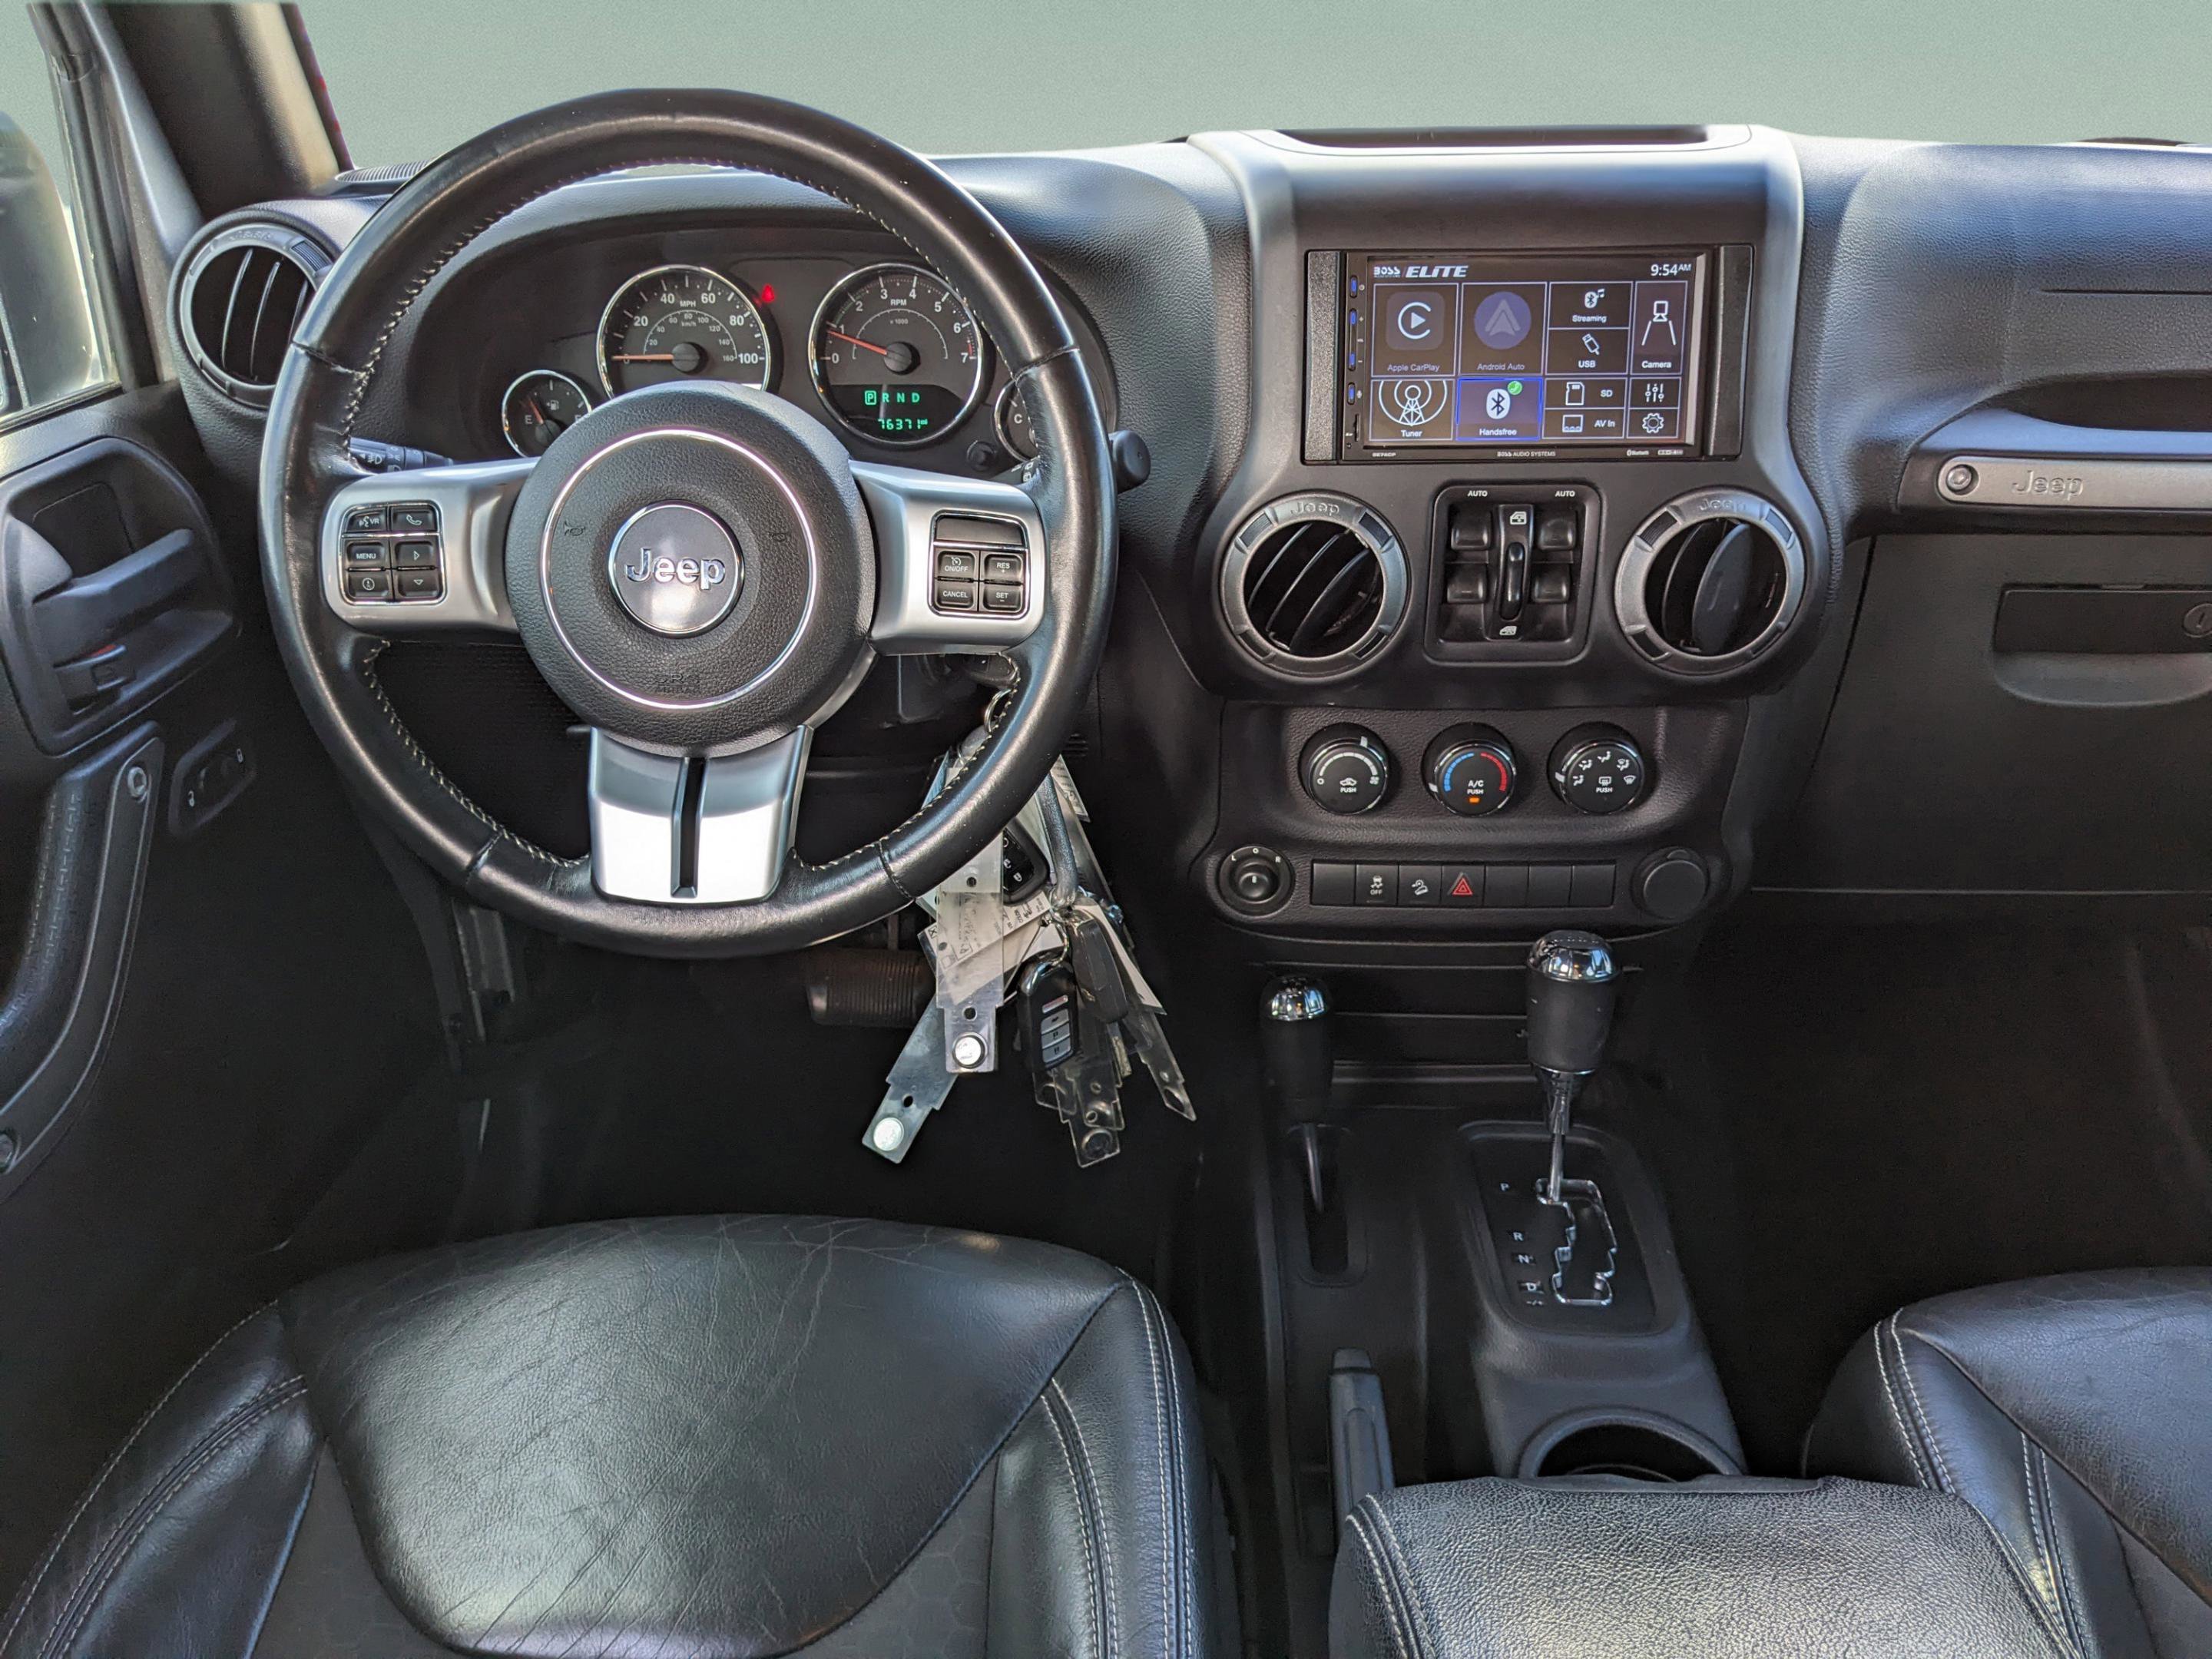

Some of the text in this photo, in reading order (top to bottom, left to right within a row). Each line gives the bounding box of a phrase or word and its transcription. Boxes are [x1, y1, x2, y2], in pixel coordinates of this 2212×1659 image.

[1373, 267, 1401, 275] BOSS
[661, 293, 675, 304] 40
[700, 293, 716, 304] 60
[881, 288, 889, 300] 3
[909, 288, 916, 300] 4
[855, 301, 863, 312] 2
[934, 302, 942, 313] 5
[634, 316, 648, 326] 20
[730, 315, 744, 326] 80
[1572, 315, 1607, 323] Streaming
[839, 324, 845, 334] 1
[953, 322, 961, 333] 6
[738, 353, 758, 364] 100
[831, 353, 839, 364] 0
[961, 353, 969, 363] 7
[1387, 363, 1440, 373] Apple CarPlay
[1641, 360, 1672, 369] Camera
[882, 392, 890, 403] R
[896, 392, 906, 403] N
[912, 392, 920, 403] D
[525, 415, 533, 425] E
[1014, 414, 1022, 424] C
[2012, 469, 2084, 501] Jeep
[1290, 502, 1340, 516] Jeep
[625, 548, 726, 591] Jeep
[1468, 780, 1485, 788] A/C
[1500, 1183, 1510, 1191] P
[1512, 1232, 1524, 1241] R
[1518, 1254, 1529, 1263] N
[1526, 1282, 1537, 1292] D
